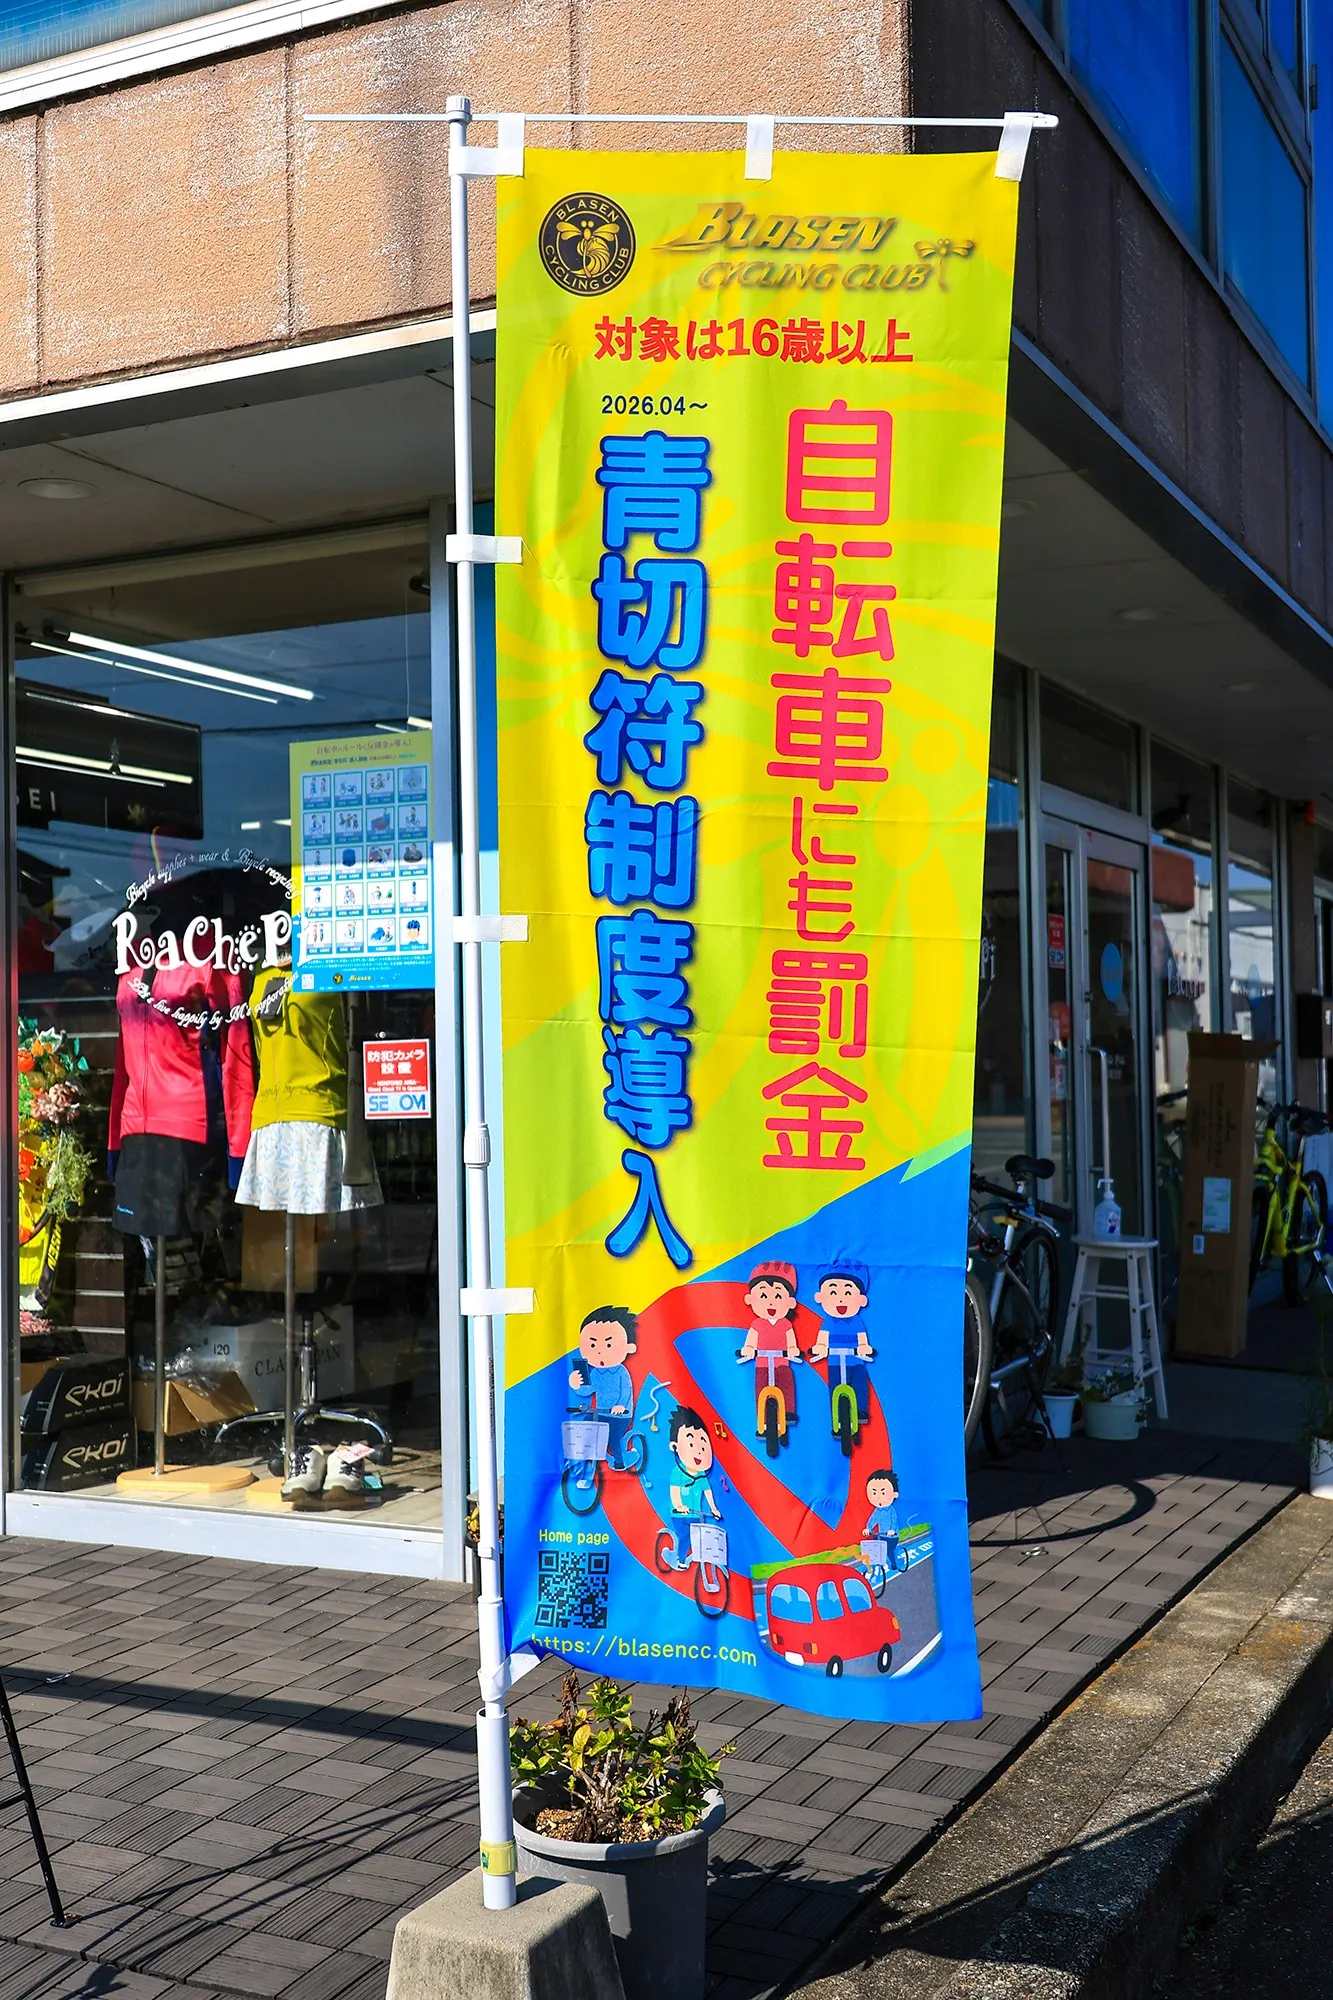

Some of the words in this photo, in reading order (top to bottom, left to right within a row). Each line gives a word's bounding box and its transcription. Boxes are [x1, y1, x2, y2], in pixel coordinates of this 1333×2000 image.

[555, 199, 619, 222] BLASEN
[651, 202, 897, 250] BLASEN
[545, 245, 600, 290] CYCLING
[602, 247, 629, 285] CLUB
[697, 261, 840, 290] CYCLING
[841, 263, 932, 290] CLUB
[594, 315, 914, 364] 対象は16歳以上
[762, 399, 897, 1171] 自転車にも罰金
[199, 852, 219, 862] wear
[583, 430, 712, 1270] 青切符制度導入
[171, 1006, 208, 1030] happily
[209, 1010, 222, 1030] by
[367, 1049, 425, 1063] 防犯カメラ
[369, 1094, 426, 1112] SEOM
[214, 1343, 230, 1355] 120
[539, 1530, 573, 1543] Home
[577, 1532, 609, 1546] page
[531, 1633, 757, 1667] https://blasencc.com
